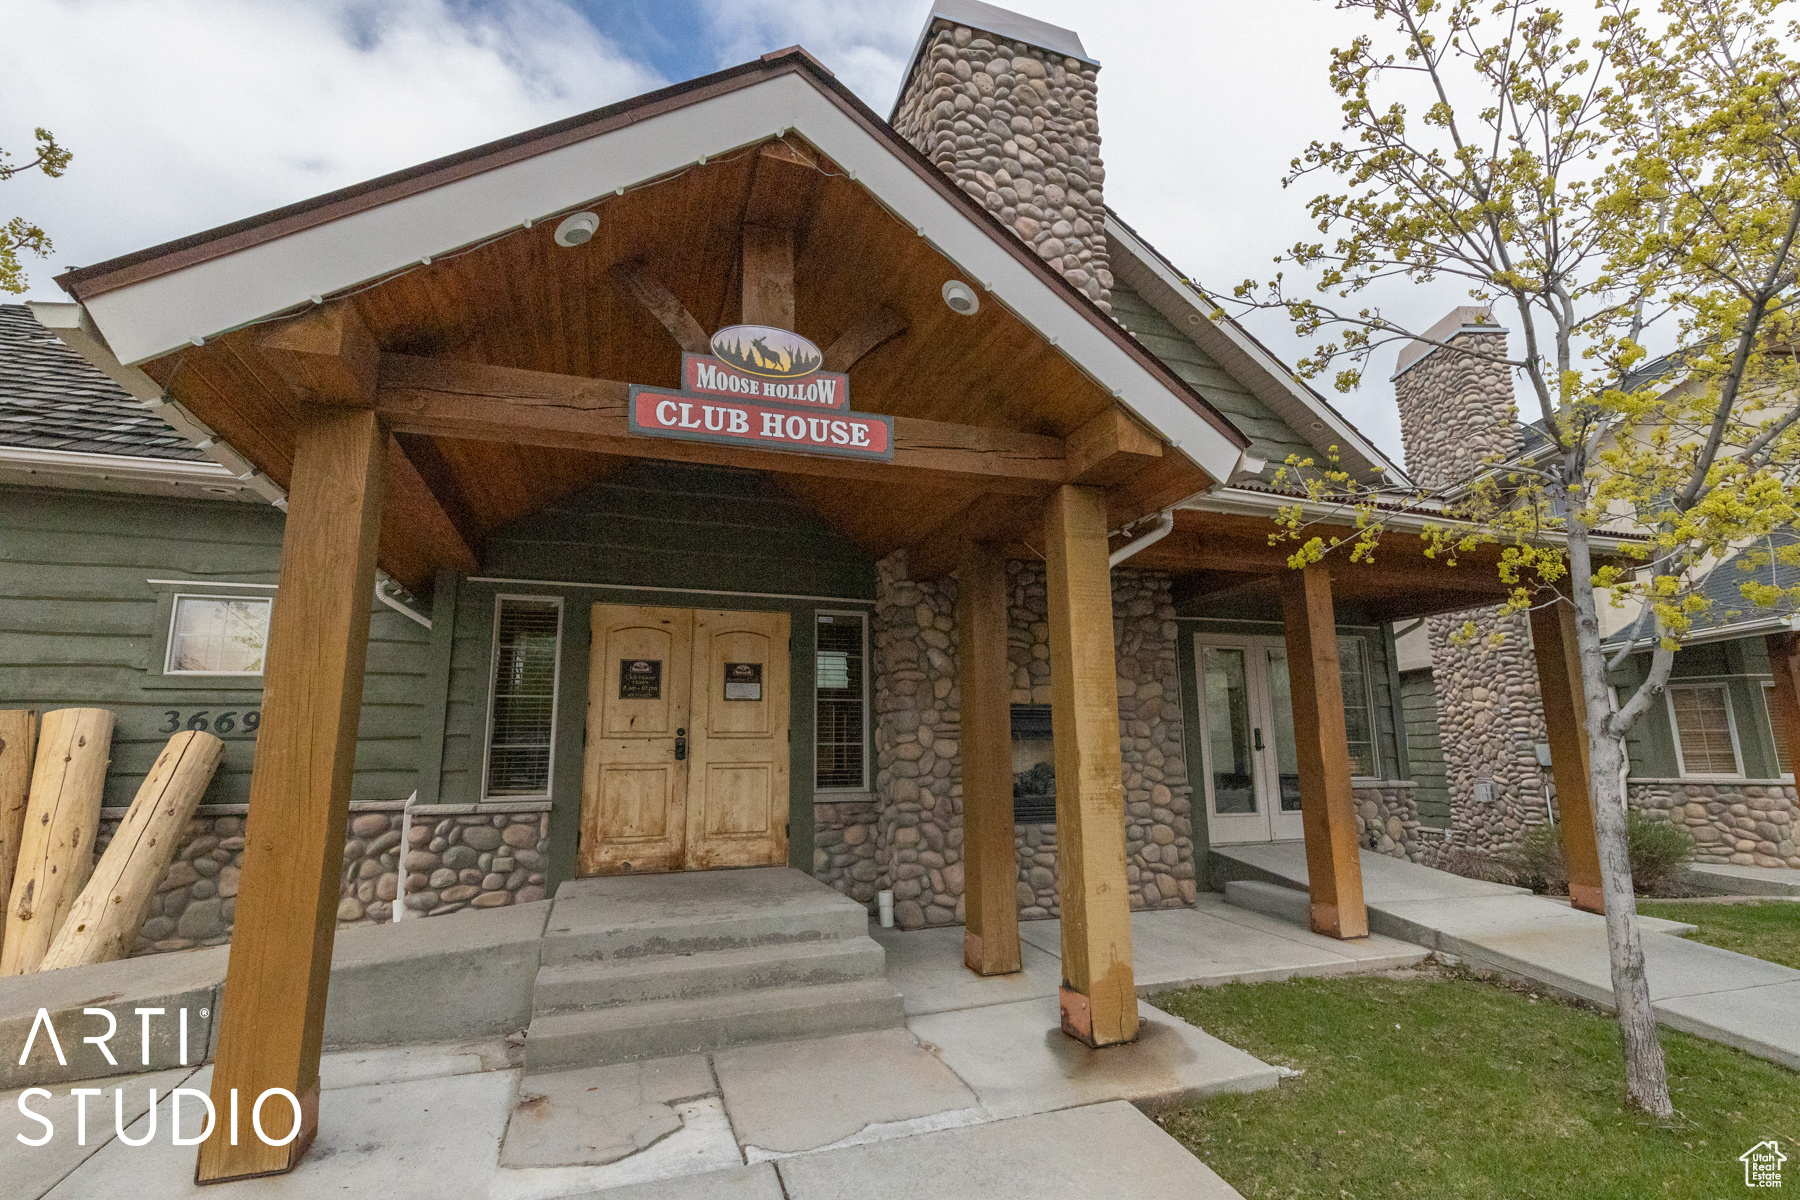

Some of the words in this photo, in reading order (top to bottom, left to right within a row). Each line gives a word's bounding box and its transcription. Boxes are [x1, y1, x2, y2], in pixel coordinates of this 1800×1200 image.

[696, 362, 760, 396] MOOSE
[763, 379, 837, 404] HOLLOW
[656, 400, 750, 433] CLUB
[760, 412, 871, 447] HOUSE
[158, 710, 261, 734] 3669
